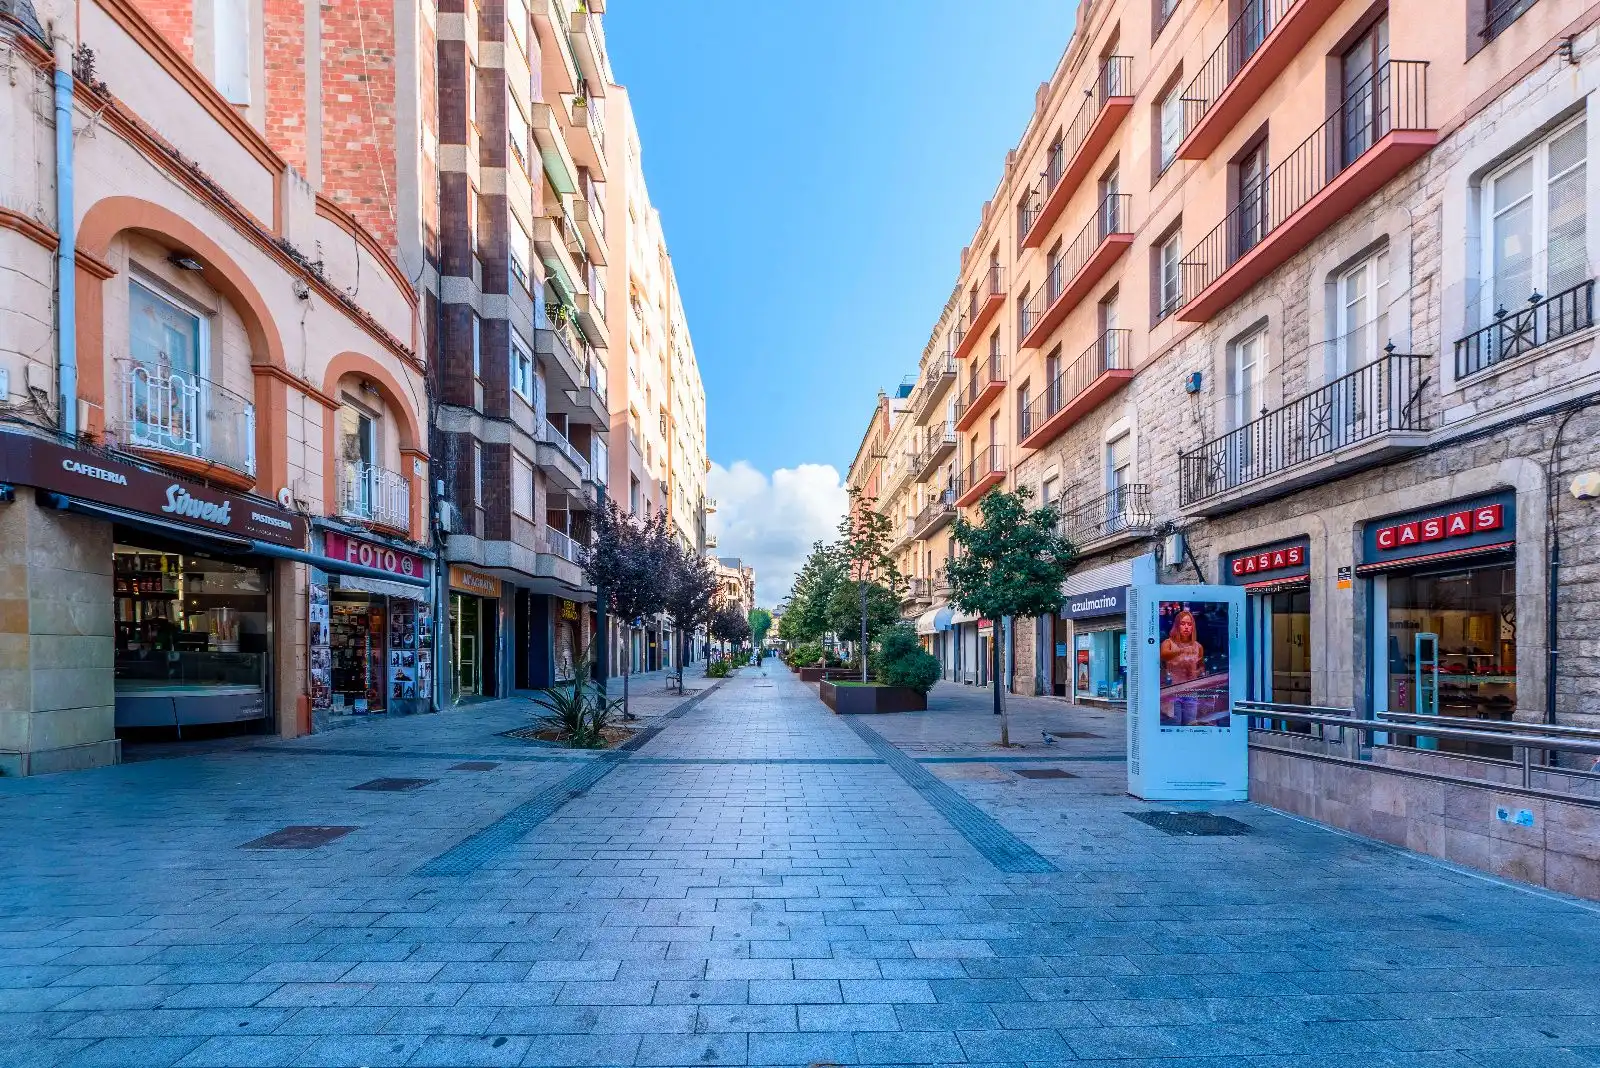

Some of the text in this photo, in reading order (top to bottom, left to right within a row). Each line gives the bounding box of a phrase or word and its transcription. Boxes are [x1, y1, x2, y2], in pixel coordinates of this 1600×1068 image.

[62, 459, 128, 486] CAFETERIA
[161, 484, 231, 526] Sirvent
[251, 511, 293, 531] PASTISSERIA
[1379, 510, 1495, 546] CASAS
[346, 540, 397, 573] FOTO
[1233, 550, 1299, 573] CASAS
[1071, 594, 1117, 613] azulmarino
